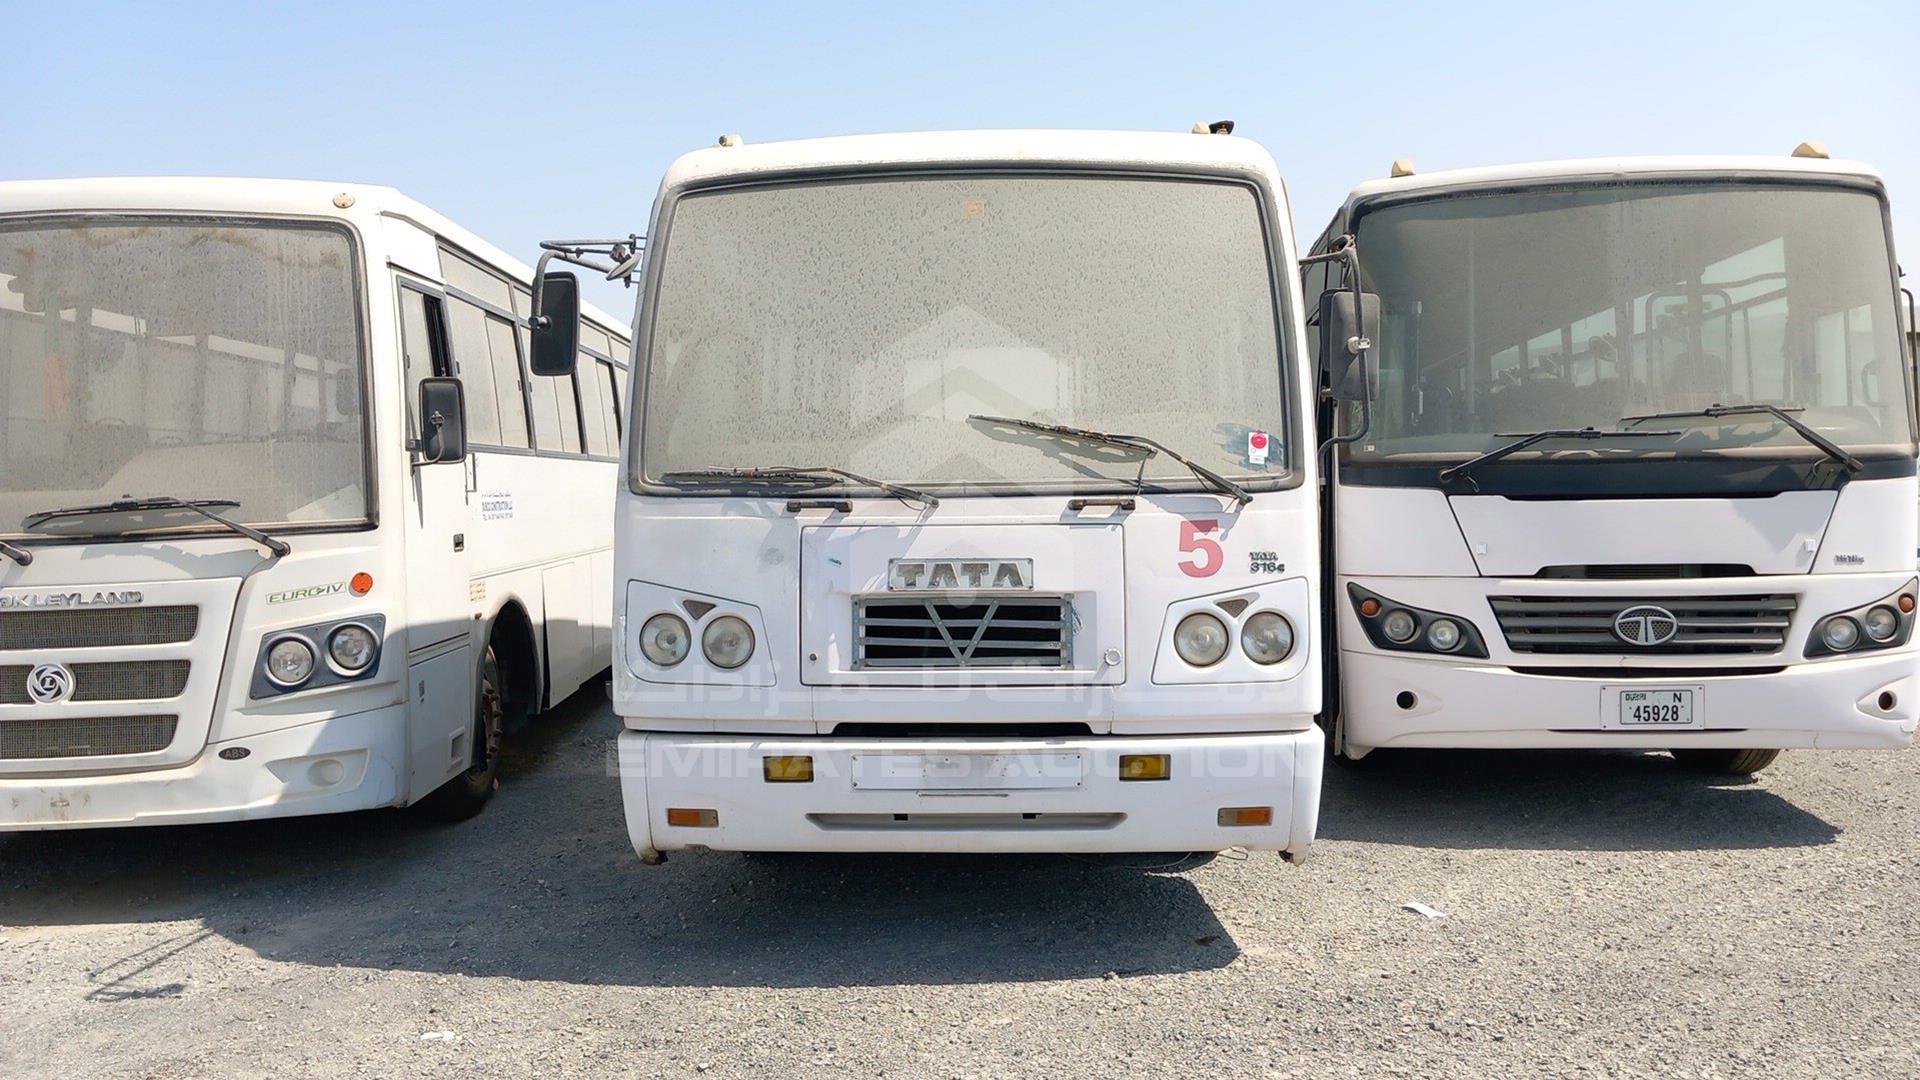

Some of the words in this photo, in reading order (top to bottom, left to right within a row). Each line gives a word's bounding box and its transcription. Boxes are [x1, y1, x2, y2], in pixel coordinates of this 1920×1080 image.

[1178, 519, 1224, 578] 5
[896, 562, 1024, 589] TATA
[1672, 692, 1683, 703] N
[1633, 705, 1679, 722] 45928
